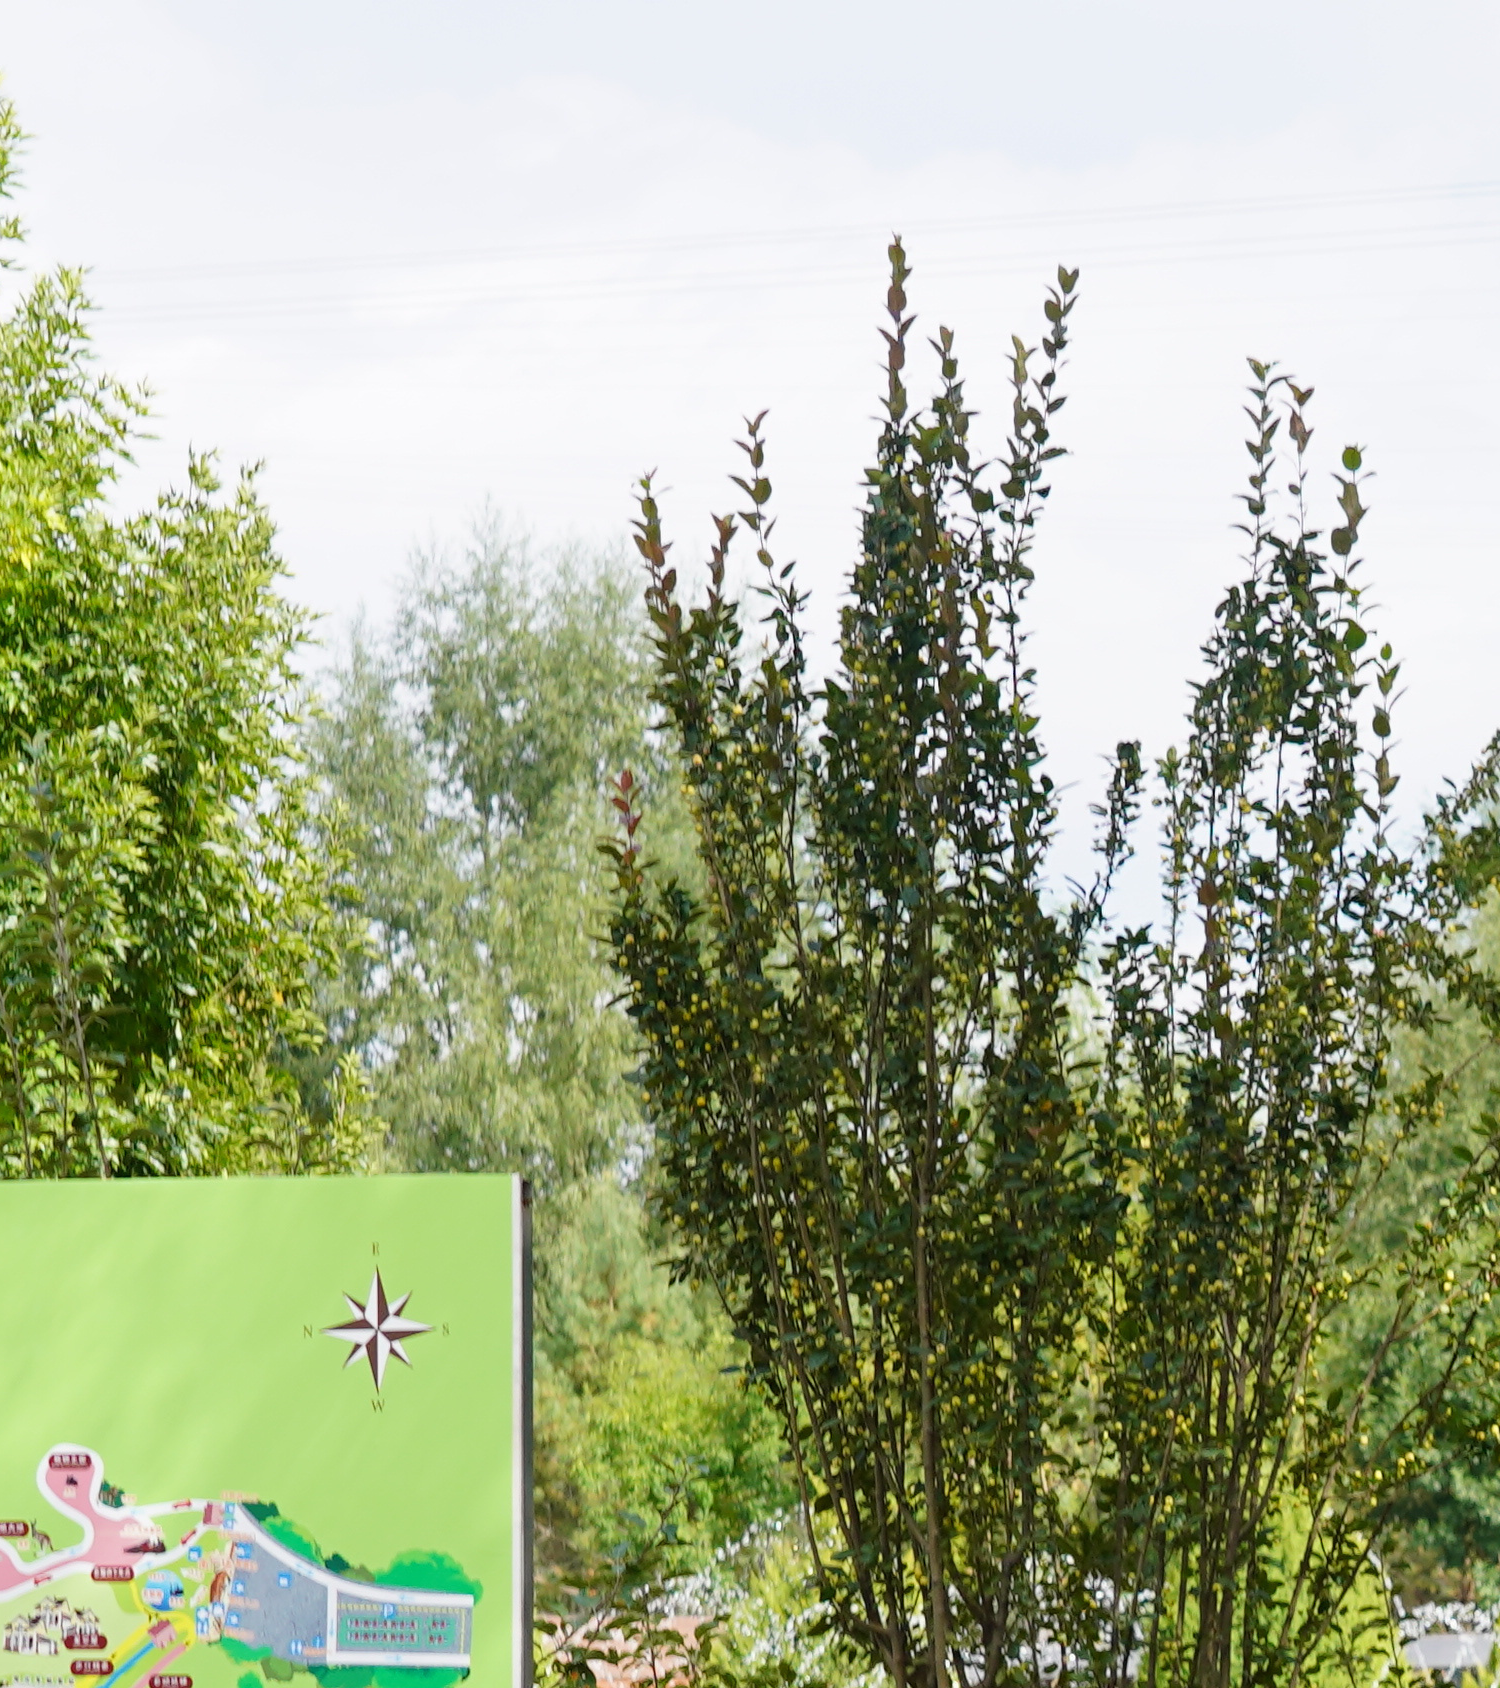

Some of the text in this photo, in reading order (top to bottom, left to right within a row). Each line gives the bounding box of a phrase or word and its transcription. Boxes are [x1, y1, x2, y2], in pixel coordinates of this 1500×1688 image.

[303, 1325, 313, 1338] N
[442, 1324, 450, 1336] S
[371, 1399, 385, 1413] W
